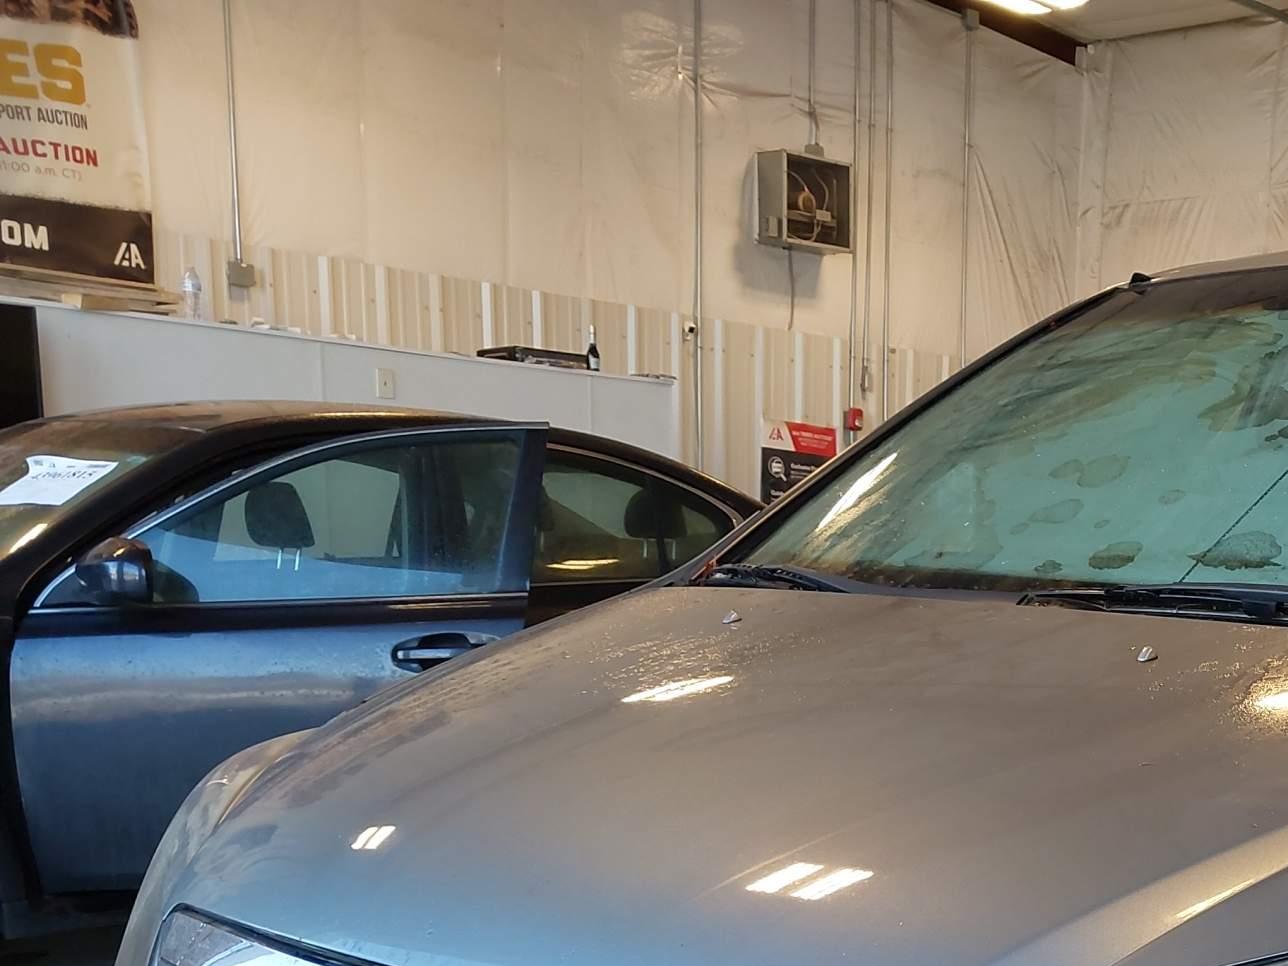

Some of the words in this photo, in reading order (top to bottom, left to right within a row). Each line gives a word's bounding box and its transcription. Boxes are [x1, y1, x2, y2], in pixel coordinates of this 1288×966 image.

[0, 38, 86, 106] ES
[37, 107, 88, 130] AUCTION
[0, 136, 98, 167] AUCTION
[1, 218, 49, 251] OM
